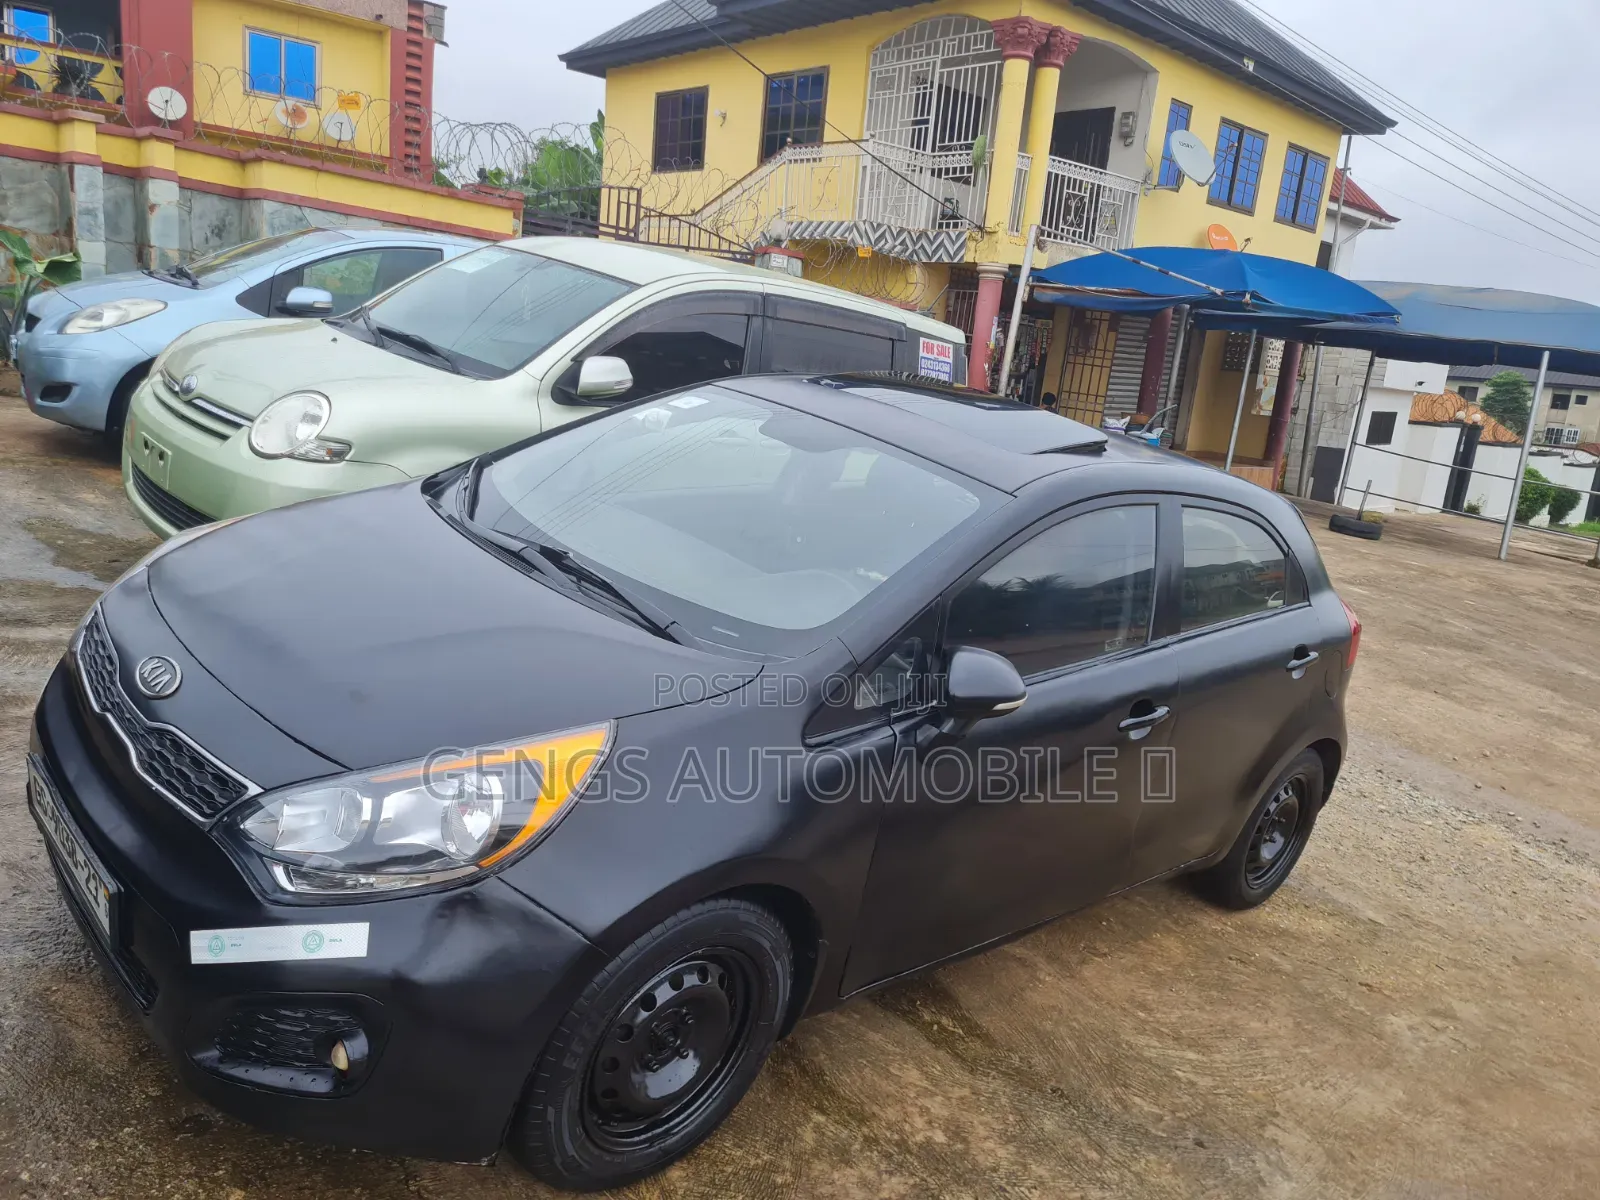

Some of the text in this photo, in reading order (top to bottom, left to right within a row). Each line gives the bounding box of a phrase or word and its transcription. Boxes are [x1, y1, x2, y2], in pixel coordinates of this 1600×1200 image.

[922, 340, 951, 359] FOR SALE
[140, 658, 173, 693] KIA
